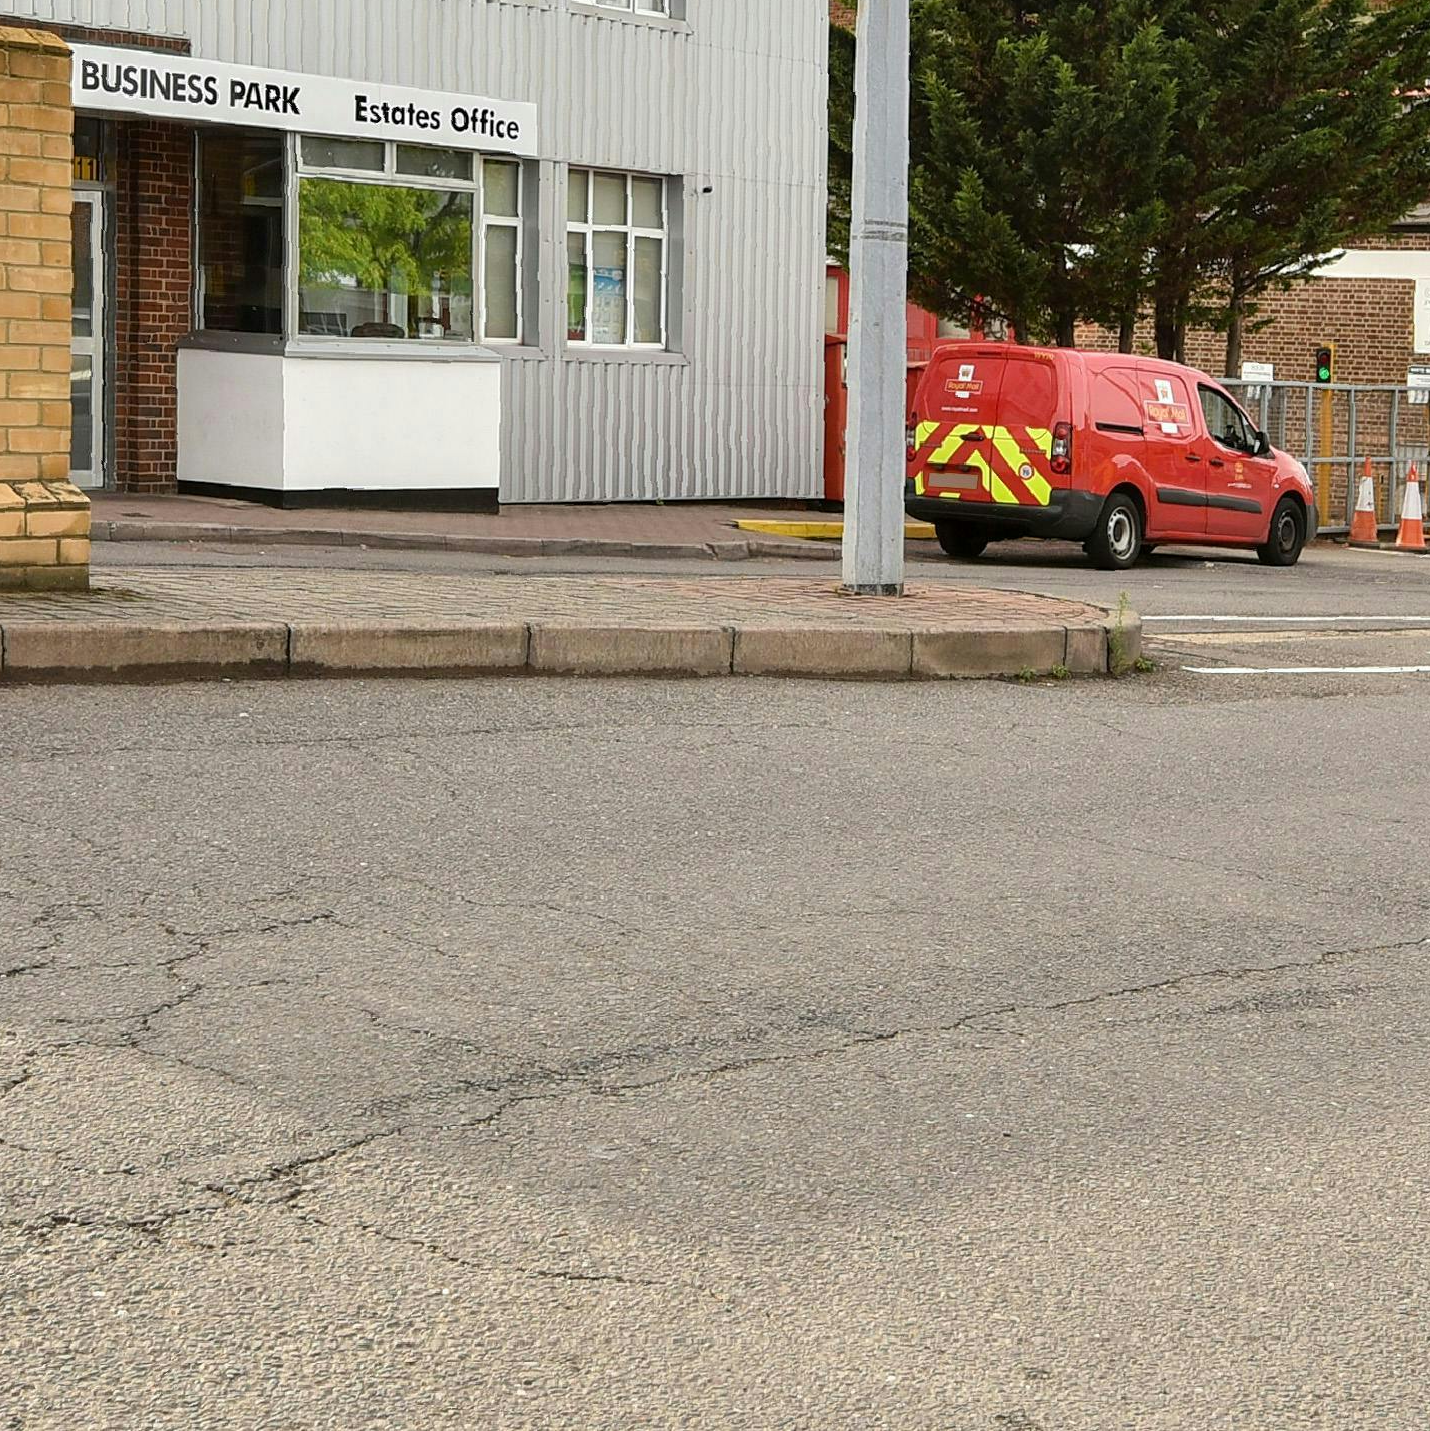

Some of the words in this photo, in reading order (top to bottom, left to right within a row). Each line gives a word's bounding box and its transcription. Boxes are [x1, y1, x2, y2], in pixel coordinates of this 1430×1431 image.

[81, 59, 218, 106] BUSINESS
[229, 79, 301, 116] PARK
[355, 95, 442, 130] Estates
[451, 107, 520, 140] Office
[948, 381, 966, 389] Royal
